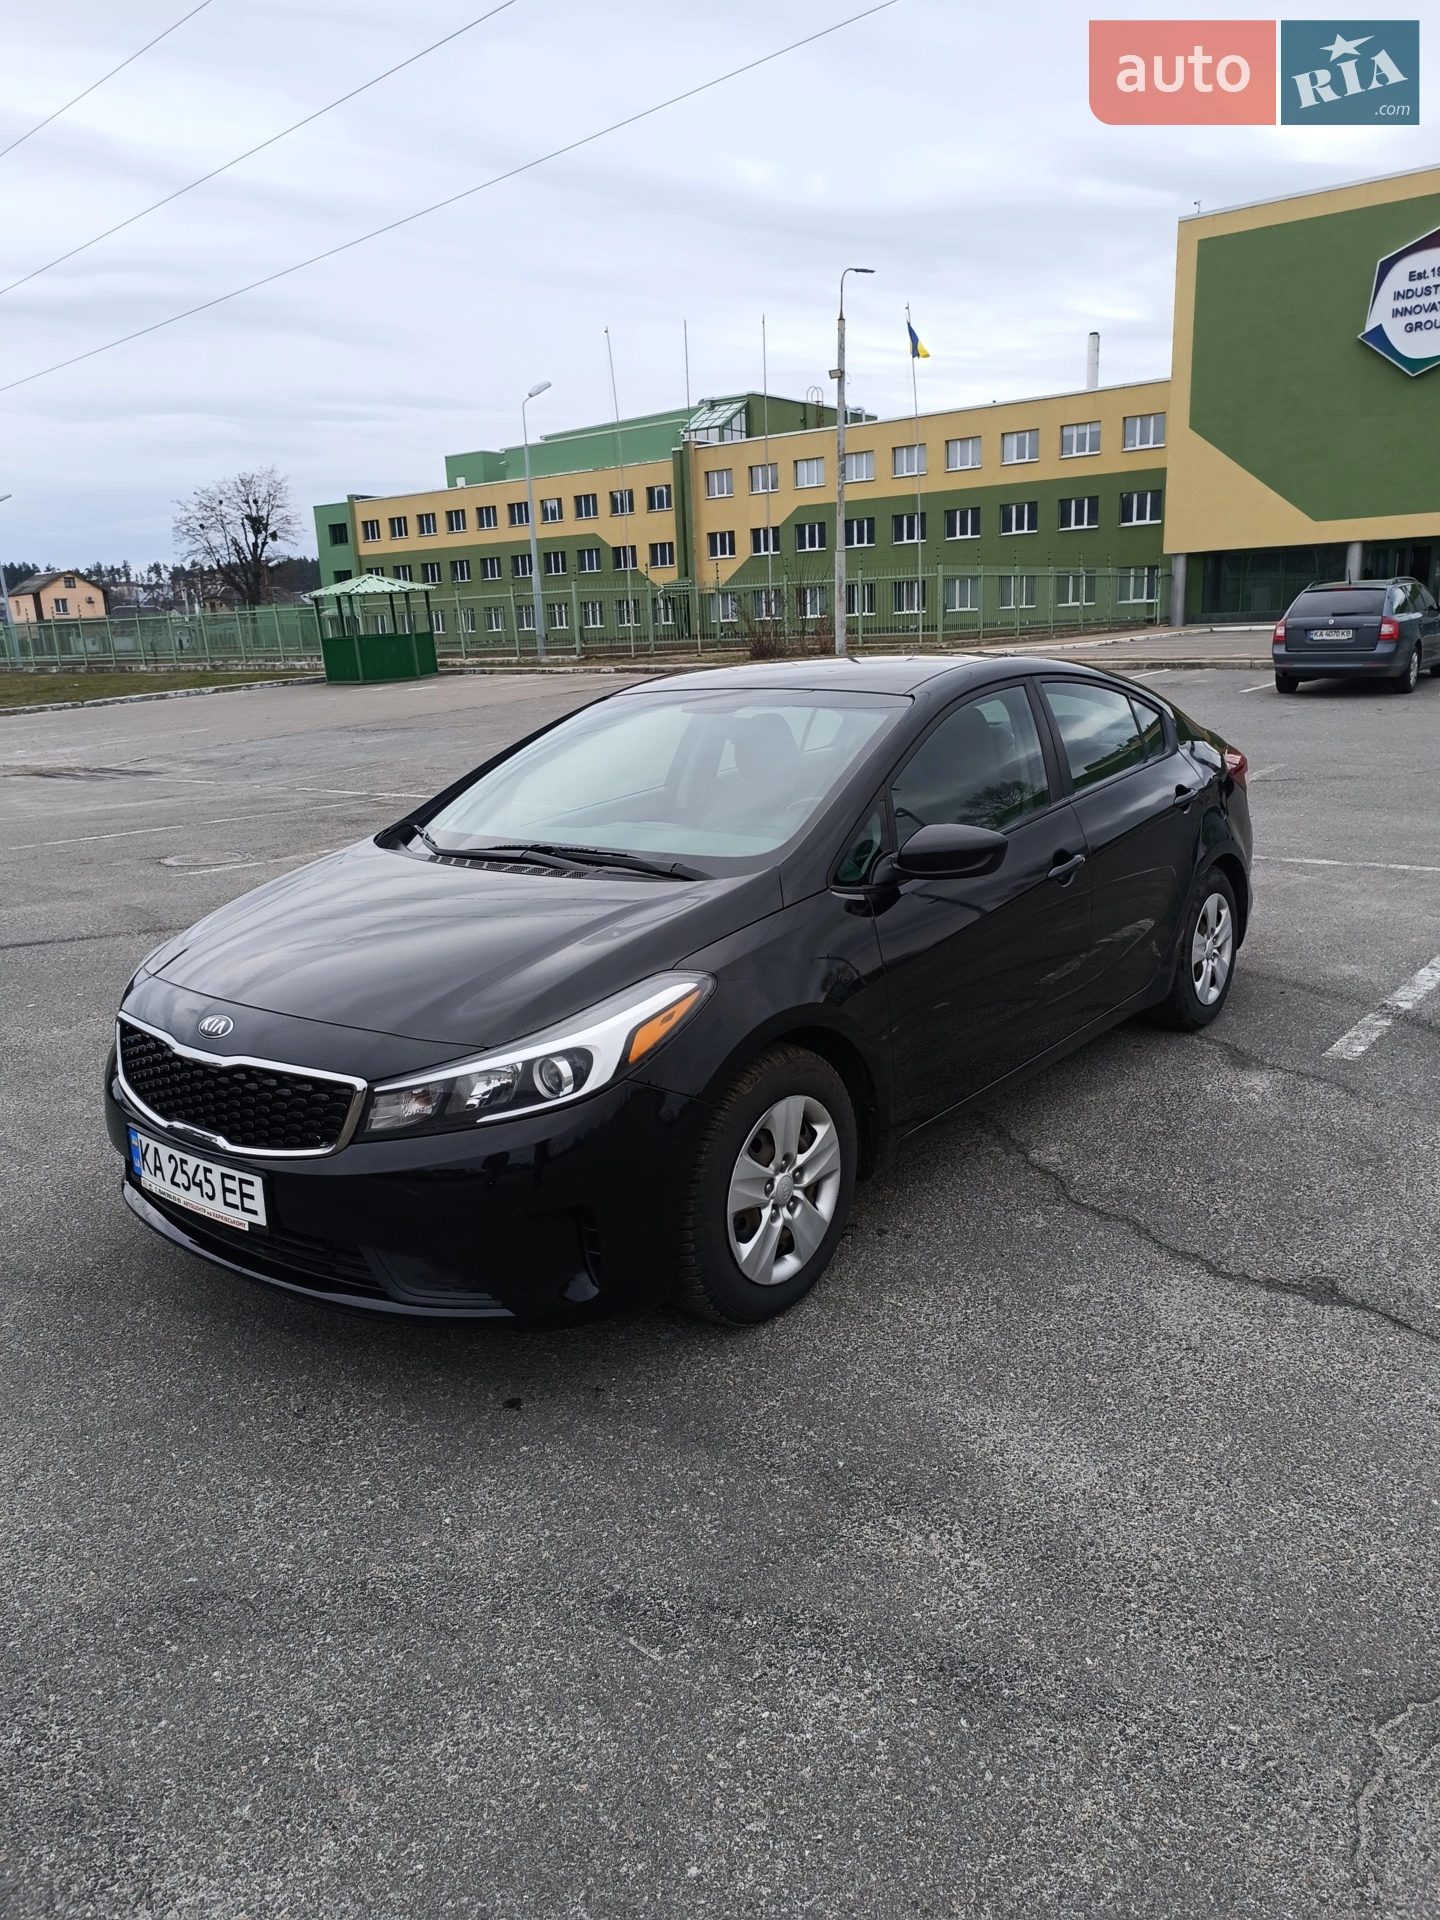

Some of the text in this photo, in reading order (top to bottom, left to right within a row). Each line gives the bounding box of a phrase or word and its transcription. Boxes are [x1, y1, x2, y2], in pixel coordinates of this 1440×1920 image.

[1313, 630, 1324, 638] KA
[200, 1017, 226, 1034] KIA
[139, 1138, 259, 1216] KA 2545 EE
